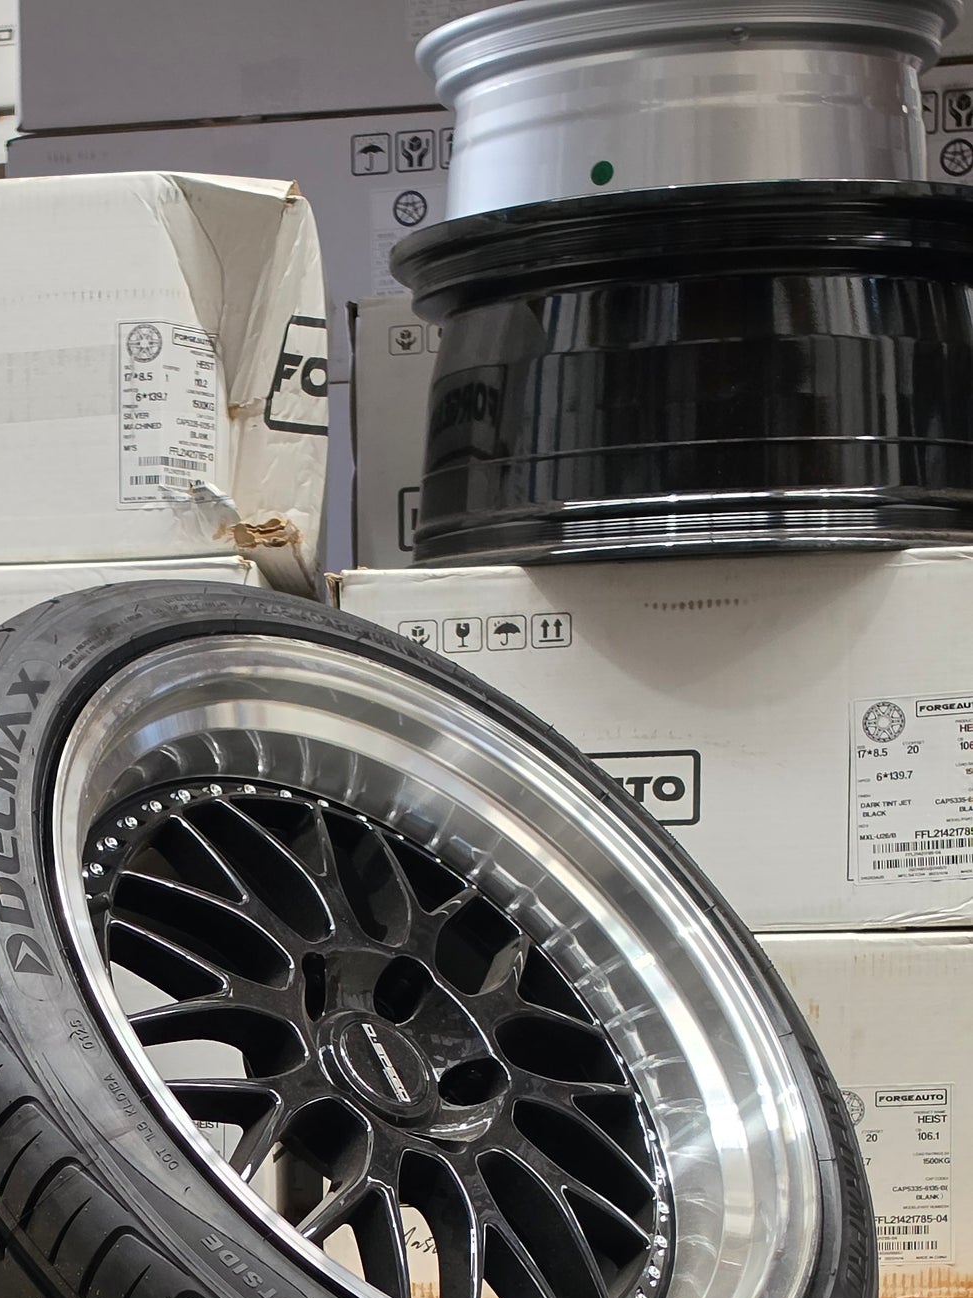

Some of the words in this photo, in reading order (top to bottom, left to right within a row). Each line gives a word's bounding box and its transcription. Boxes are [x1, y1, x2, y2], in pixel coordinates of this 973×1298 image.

[907, 745, 919, 755] 20
[613, 776, 685, 802] TO
[860, 800, 880, 809] DARK
[882, 799, 897, 807] TINT
[862, 810, 886, 818] BLACK
[878, 1094, 944, 1103] FORGEAUTO
[917, 1114, 947, 1124] HEIST
[866, 1133, 878, 1142] 20
[917, 1132, 940, 1141] 106.1
[156, 1148, 180, 1171] DOT
[923, 1157, 951, 1165] 1500KG
